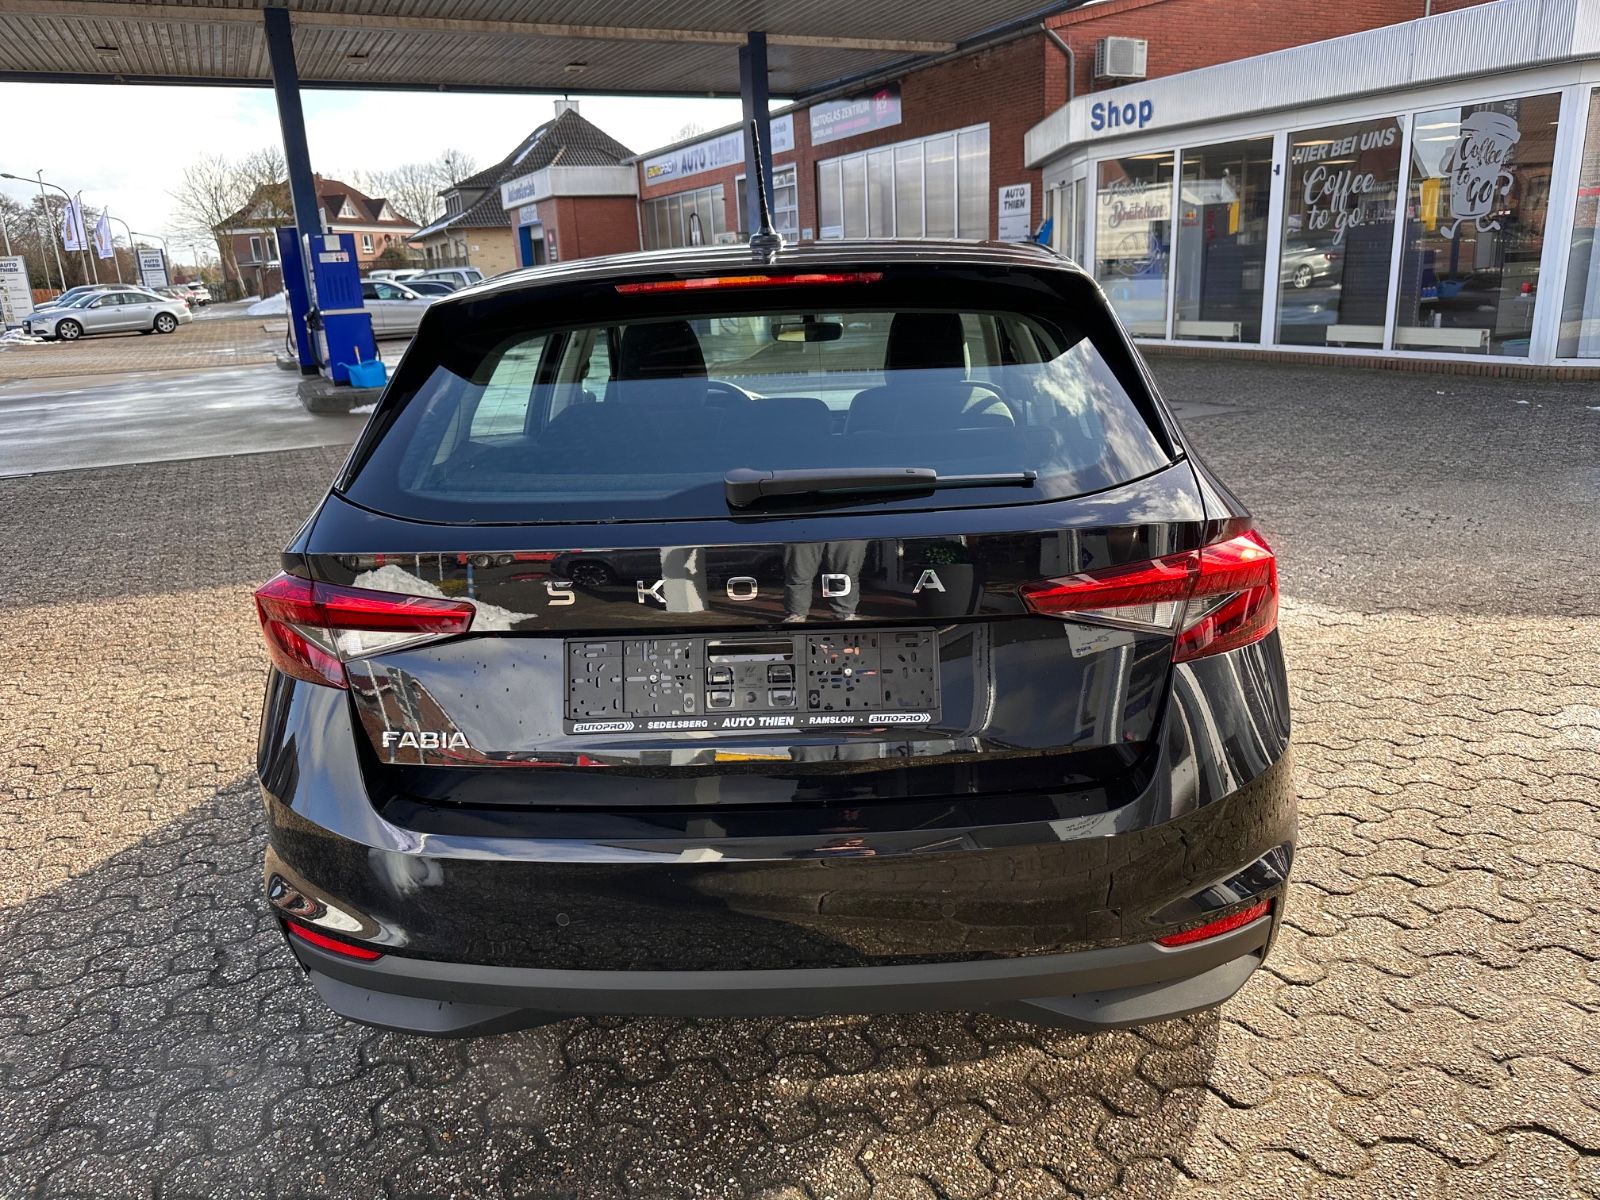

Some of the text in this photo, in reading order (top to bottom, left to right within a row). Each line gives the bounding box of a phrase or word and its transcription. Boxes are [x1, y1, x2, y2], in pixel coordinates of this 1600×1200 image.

[1091, 99, 1153, 131] Shop
[681, 148, 706, 174] AUTO
[709, 136, 740, 167] THIEN
[1293, 127, 1396, 165] HIER BEI UNS
[1460, 133, 1504, 165] Coffee
[1454, 162, 1471, 185] to
[1005, 188, 1025, 199] AUTO
[1303, 166, 1375, 213] Coffee
[1004, 199, 1026, 210] THIEN
[1307, 205, 1331, 231] to
[647, 720, 708, 729] SEDELSBERG
[722, 717, 755, 727] AUTO
[758, 716, 794, 726] THIEN
[809, 716, 854, 724] RAMSLOH
[382, 731, 470, 749] FABIA
